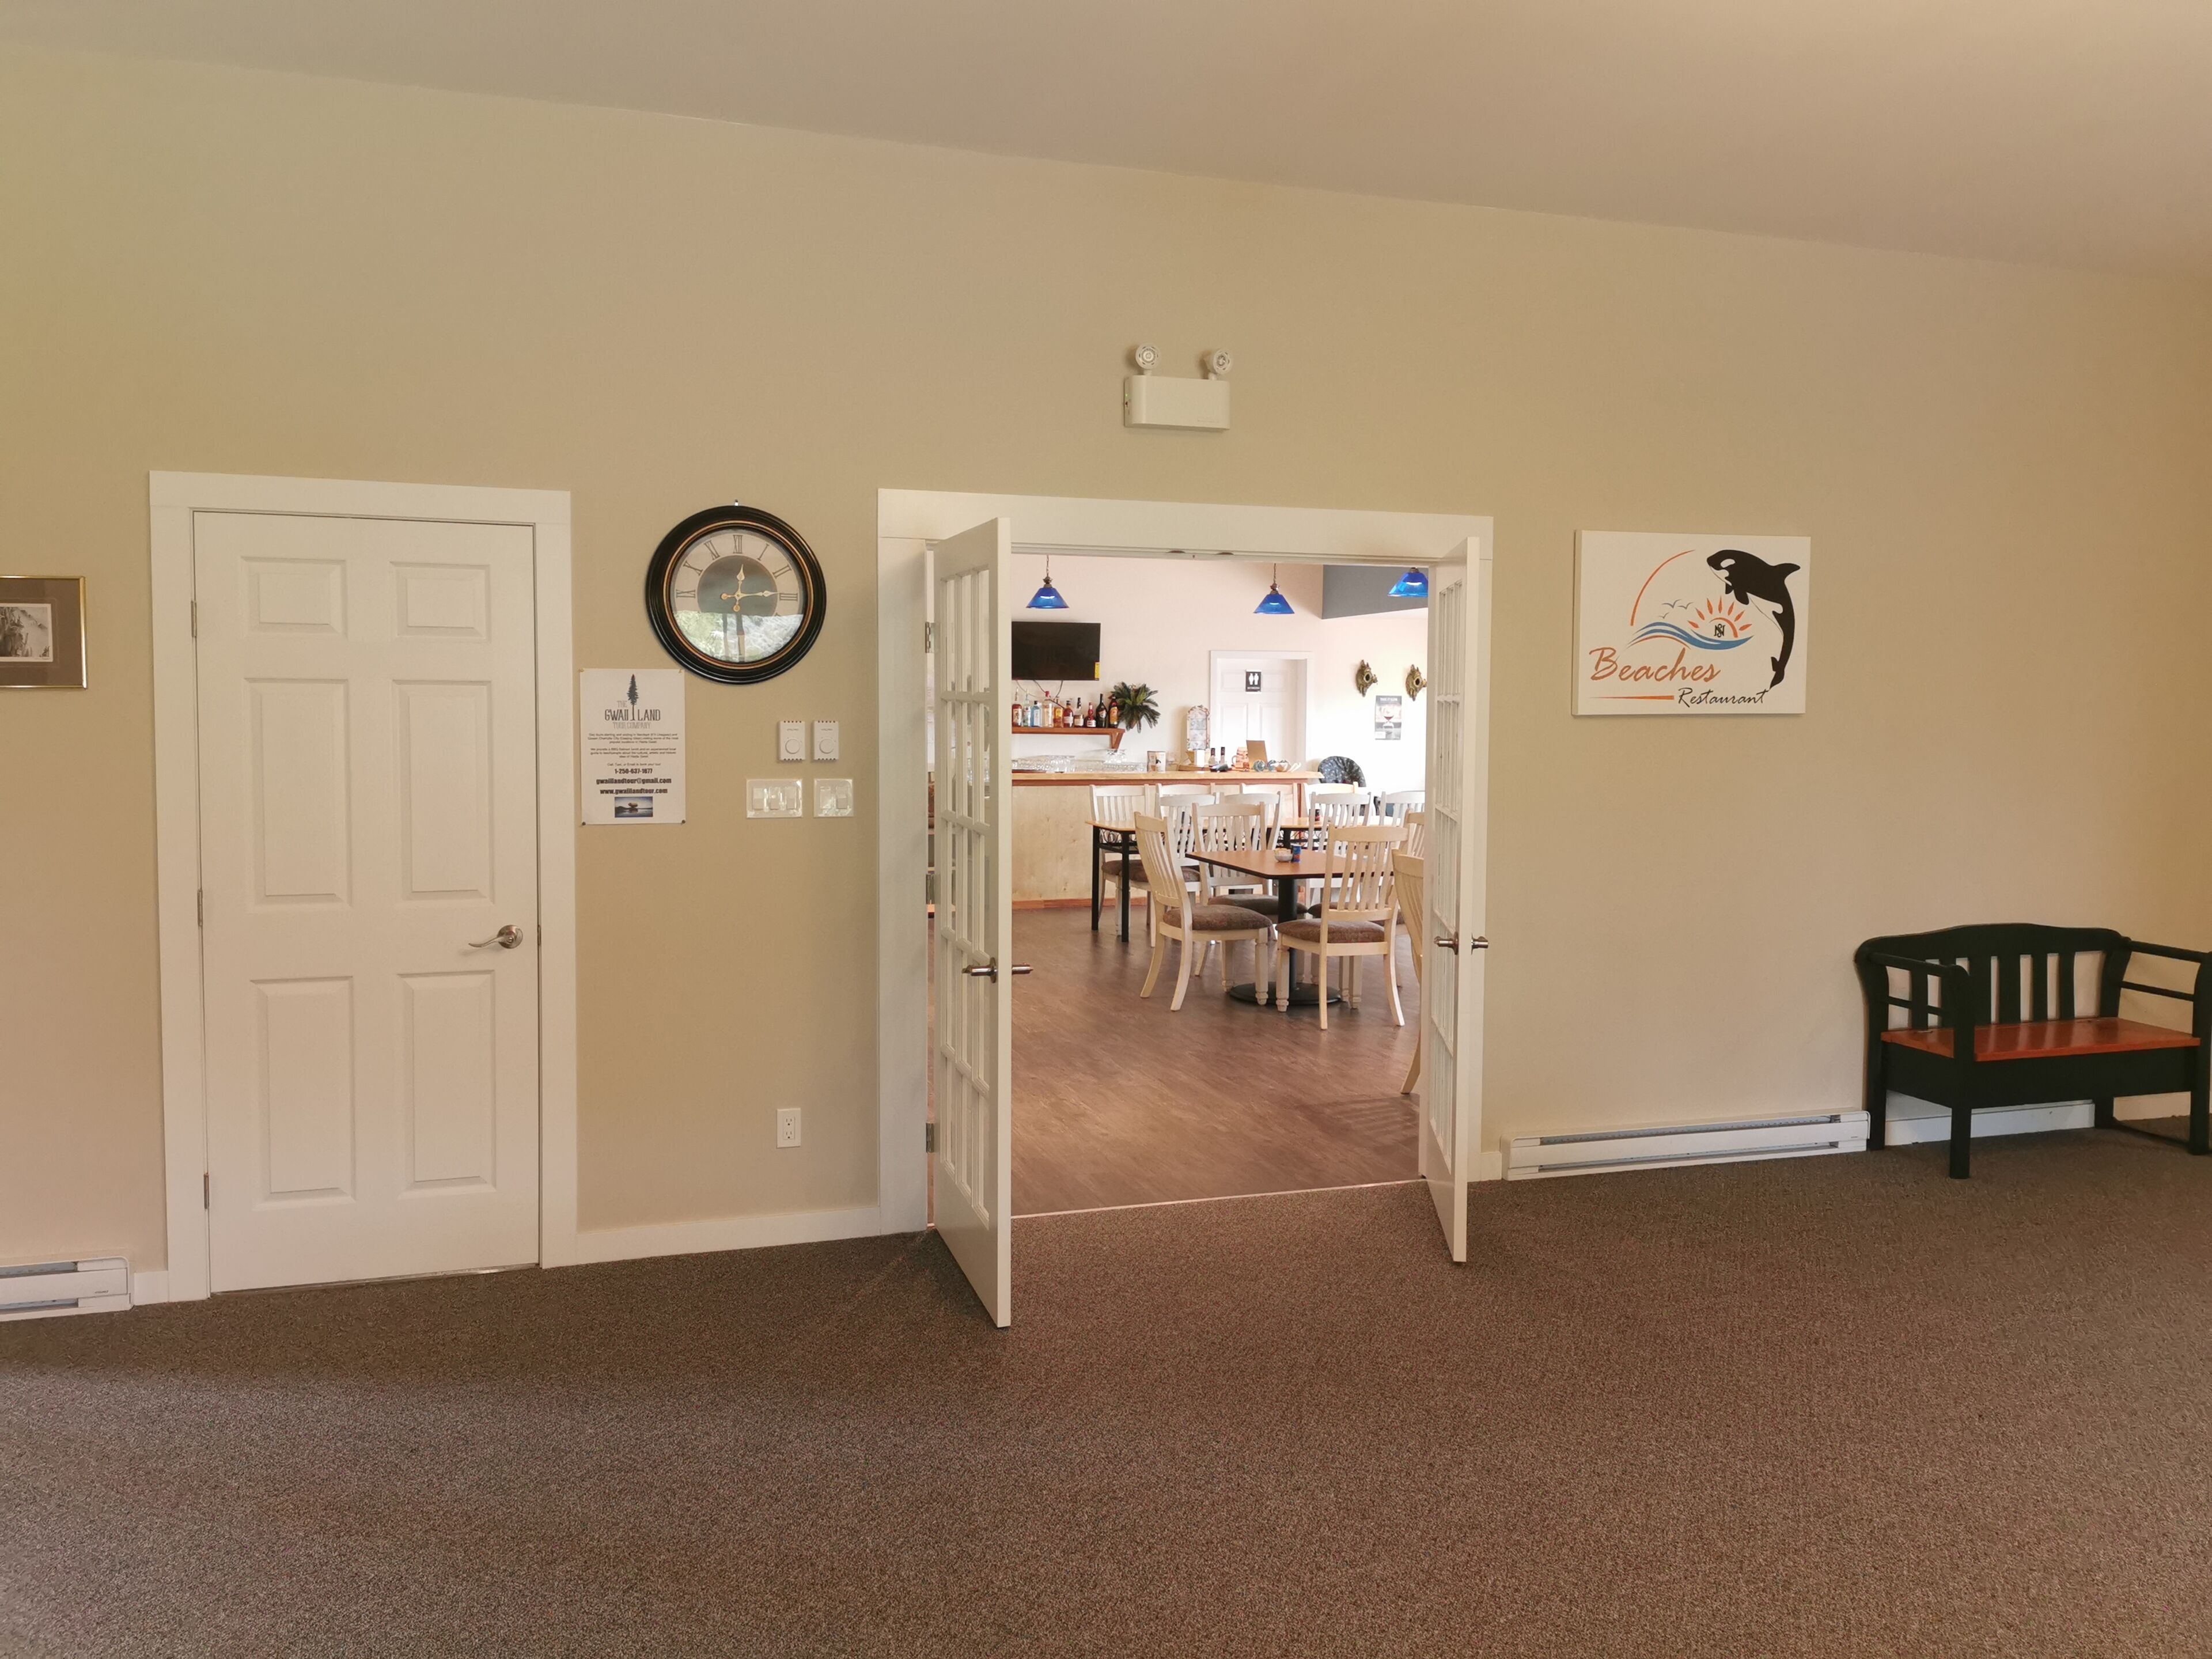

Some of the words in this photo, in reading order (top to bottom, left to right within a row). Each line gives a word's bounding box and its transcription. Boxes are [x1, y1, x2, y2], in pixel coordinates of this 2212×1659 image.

[733, 535, 743, 554] XII
[1589, 647, 1722, 682] Beaches
[1677, 687, 1770, 708] Restaurant
[604, 709, 629, 721] GWAII
[638, 709, 661, 721] LAND
